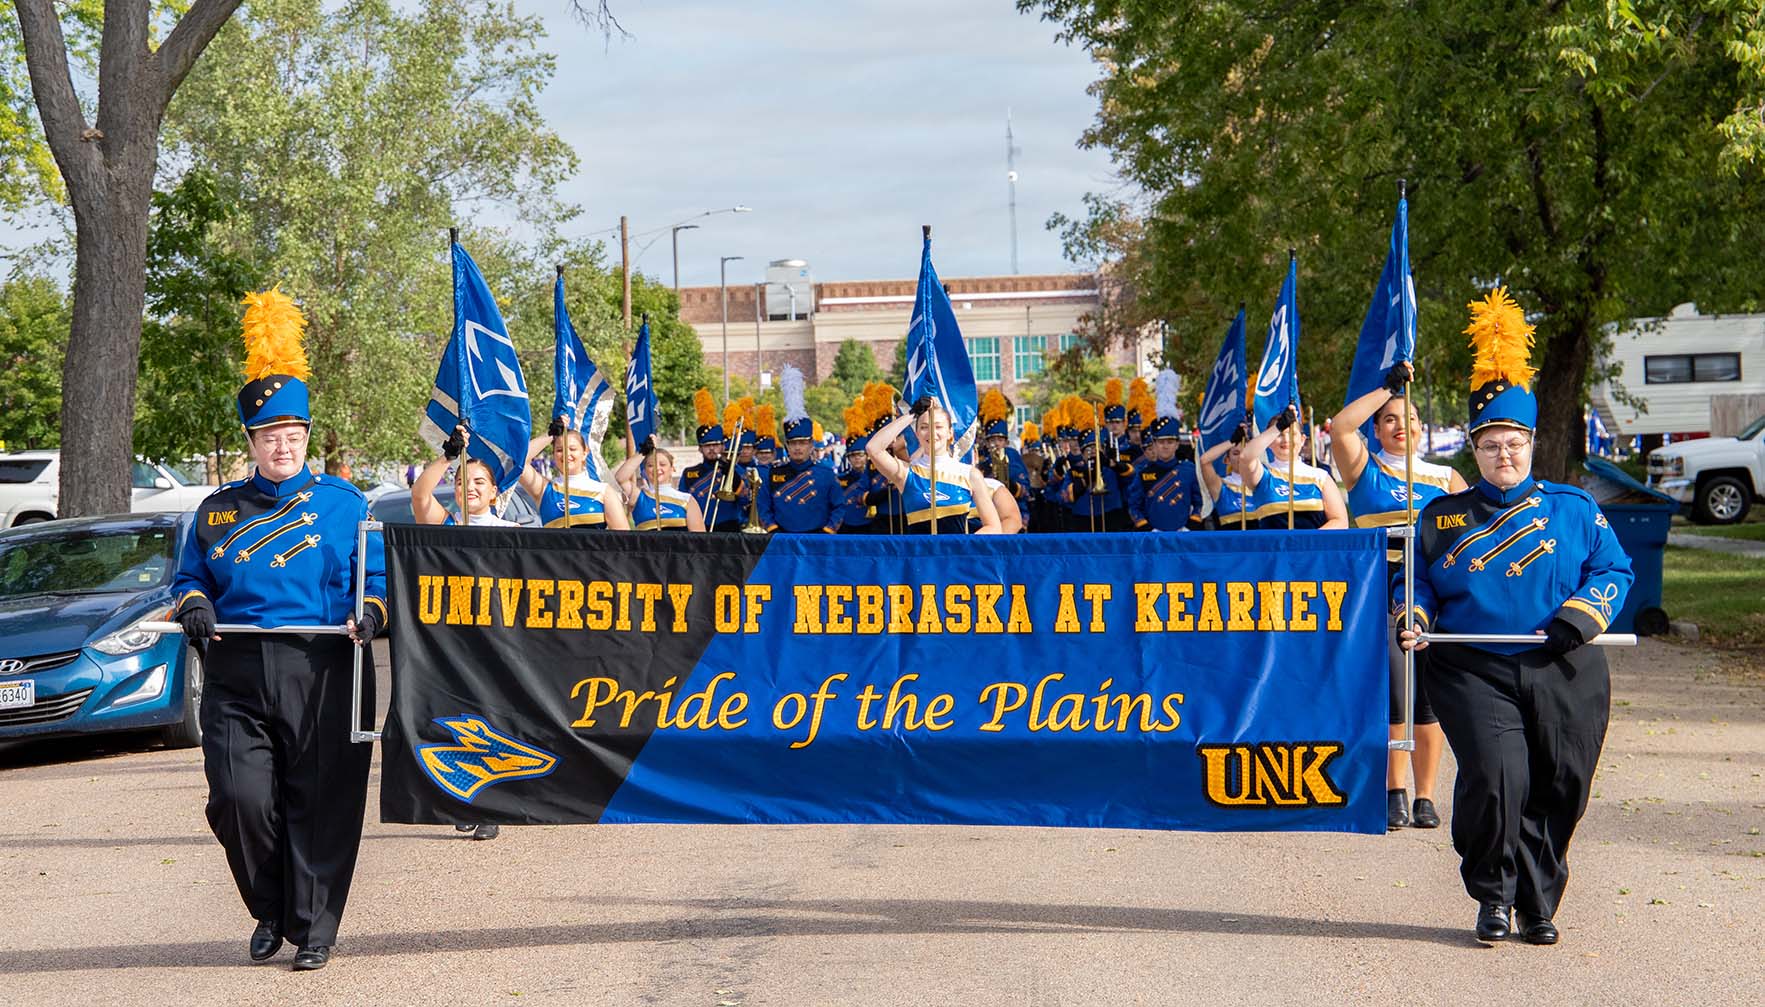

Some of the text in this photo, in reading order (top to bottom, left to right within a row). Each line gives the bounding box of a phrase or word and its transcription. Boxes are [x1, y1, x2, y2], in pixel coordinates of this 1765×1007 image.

[207, 510, 238, 526] UNK
[1436, 513, 1467, 530] UNK
[418, 575, 1347, 634] UNIVERSITY OF NEBRASKA AT KEARNEY
[0, 687, 28, 703] 6340
[570, 672, 1185, 749] Pride of the Plains
[1201, 745, 1342, 805] UNK
